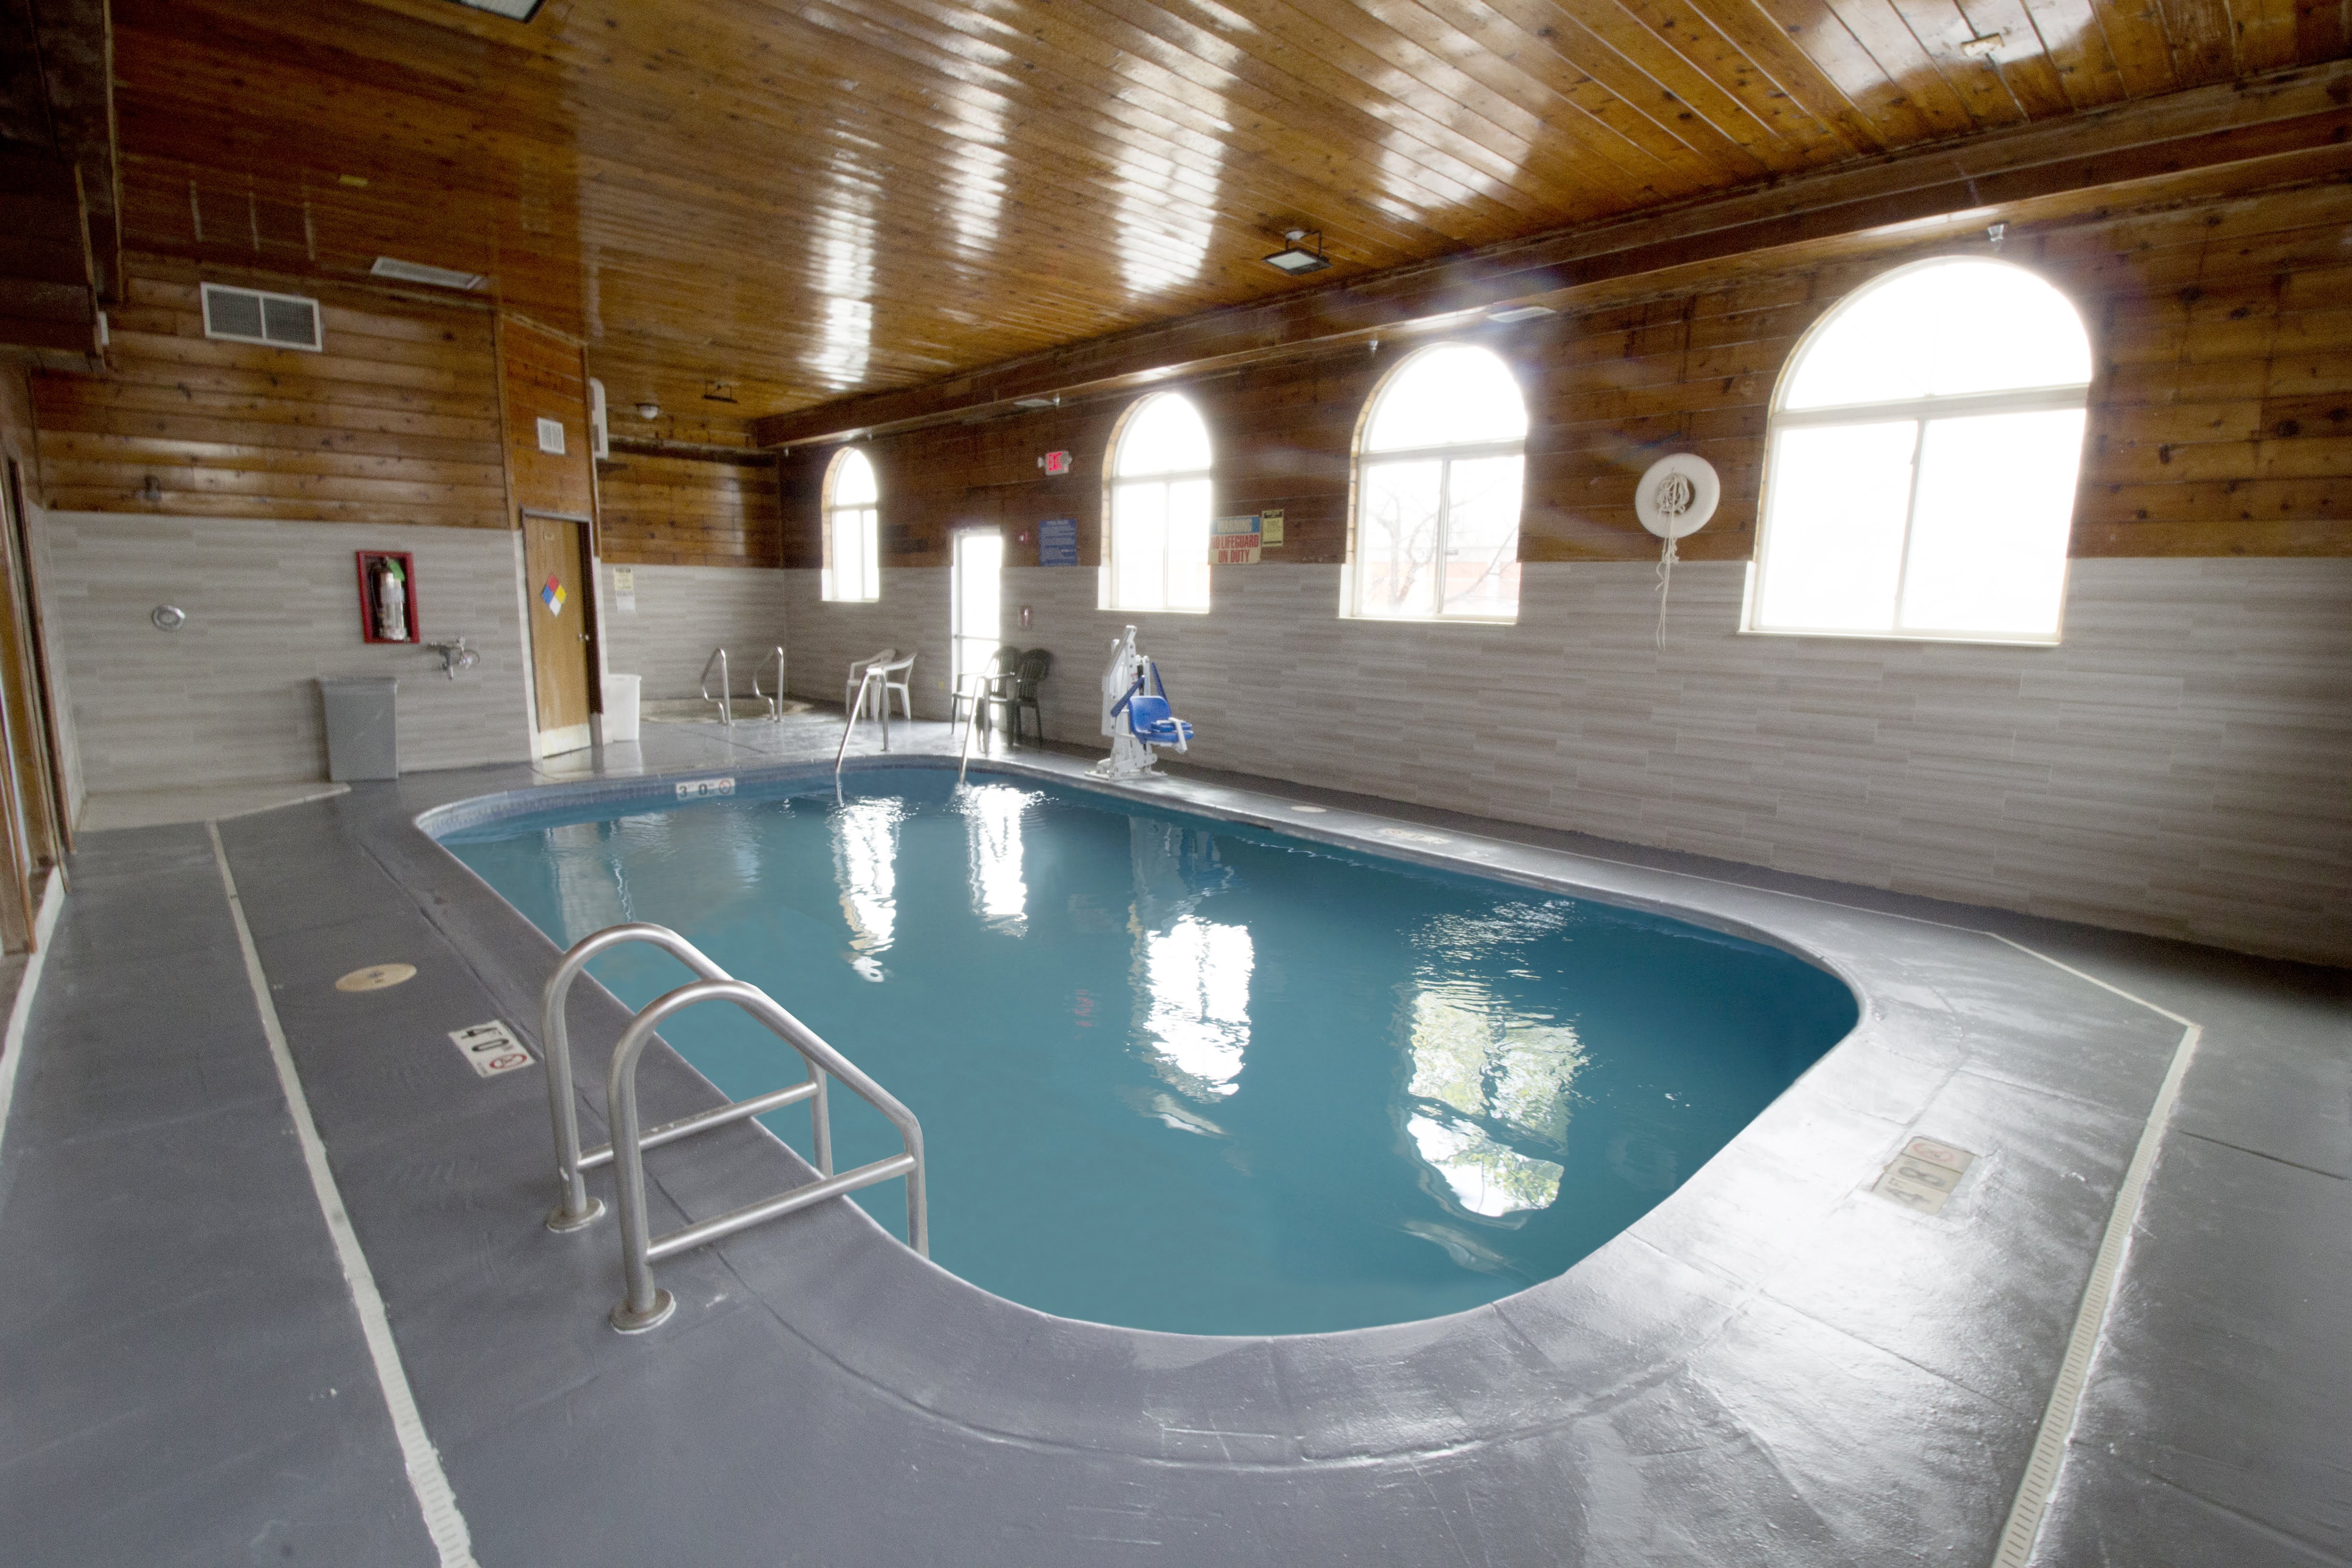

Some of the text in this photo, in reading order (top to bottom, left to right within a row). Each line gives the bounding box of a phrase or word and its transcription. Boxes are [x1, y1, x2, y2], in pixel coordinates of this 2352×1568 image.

[1221, 535, 1259, 548] LIFEGUARD
[1218, 549, 1249, 563] ON DUTY
